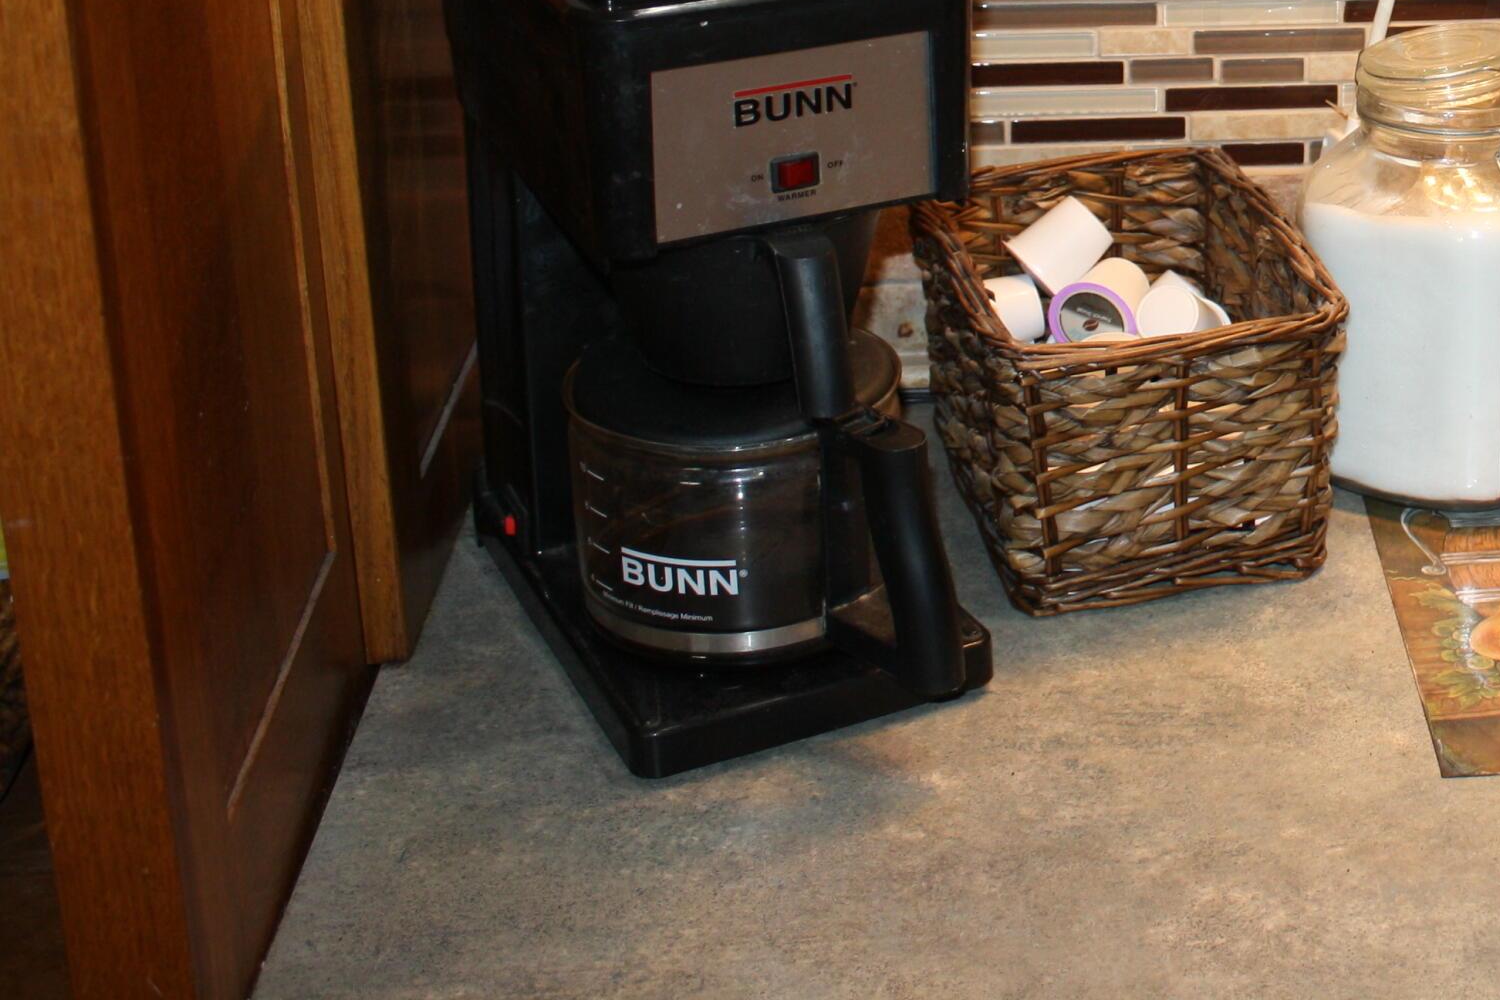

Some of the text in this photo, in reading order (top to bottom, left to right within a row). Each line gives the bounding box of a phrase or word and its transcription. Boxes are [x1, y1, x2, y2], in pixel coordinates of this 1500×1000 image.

[734, 82, 852, 128] BUNN
[827, 160, 844, 169] OFF
[751, 174, 764, 182] ON
[777, 189, 817, 201] WARMER
[621, 556, 739, 596] BUNN
